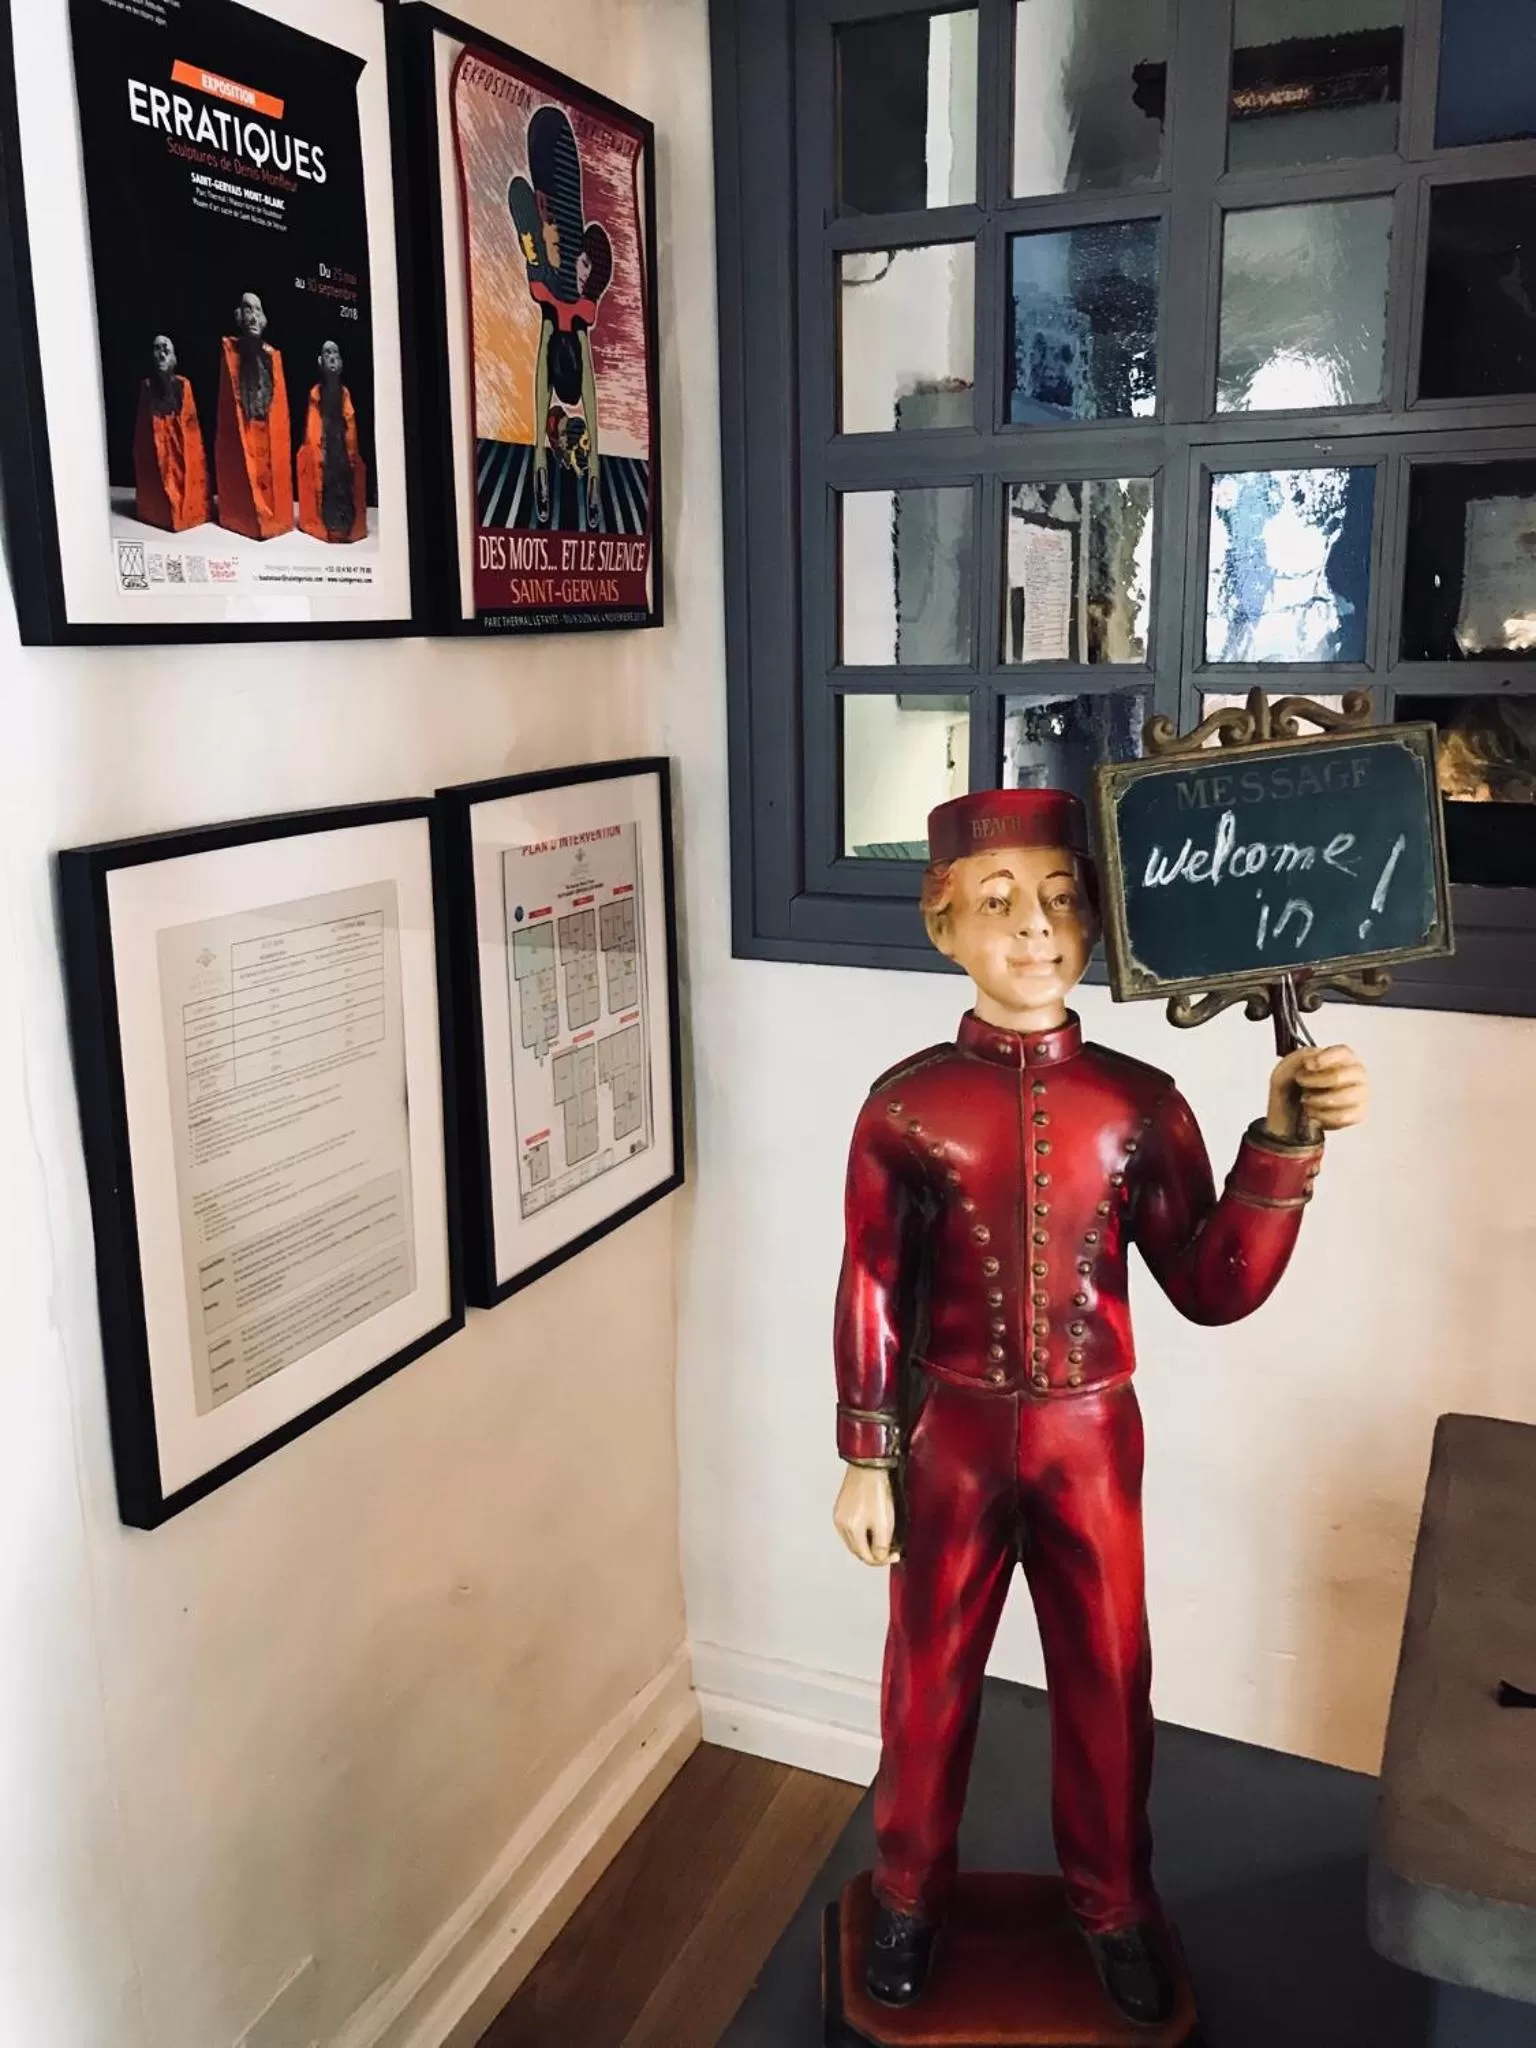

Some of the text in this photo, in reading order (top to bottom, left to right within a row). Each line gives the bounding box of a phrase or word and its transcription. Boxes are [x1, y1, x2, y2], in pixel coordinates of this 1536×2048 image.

[202, 73, 257, 107] EXPOSITION
[461, 61, 532, 111] EXPOSITION
[128, 79, 327, 184] ERRATIQUES
[166, 136, 218, 167] Sculptures
[220, 154, 232, 172] de
[190, 172, 242, 197] SAINT-GERVAIS
[243, 188, 286, 211] MONT-BLANC
[295, 277, 305, 289] au
[319, 263, 331, 279] Du
[340, 305, 358, 320] 2018
[479, 536, 646, 572] DES MOTS... ET LE SILENCE
[510, 578, 619, 604] SAINT-GERVAIS
[1176, 758, 1372, 811] MESSAGE
[521, 843, 549, 857] PLAN
[1254, 832, 1406, 951] in !
